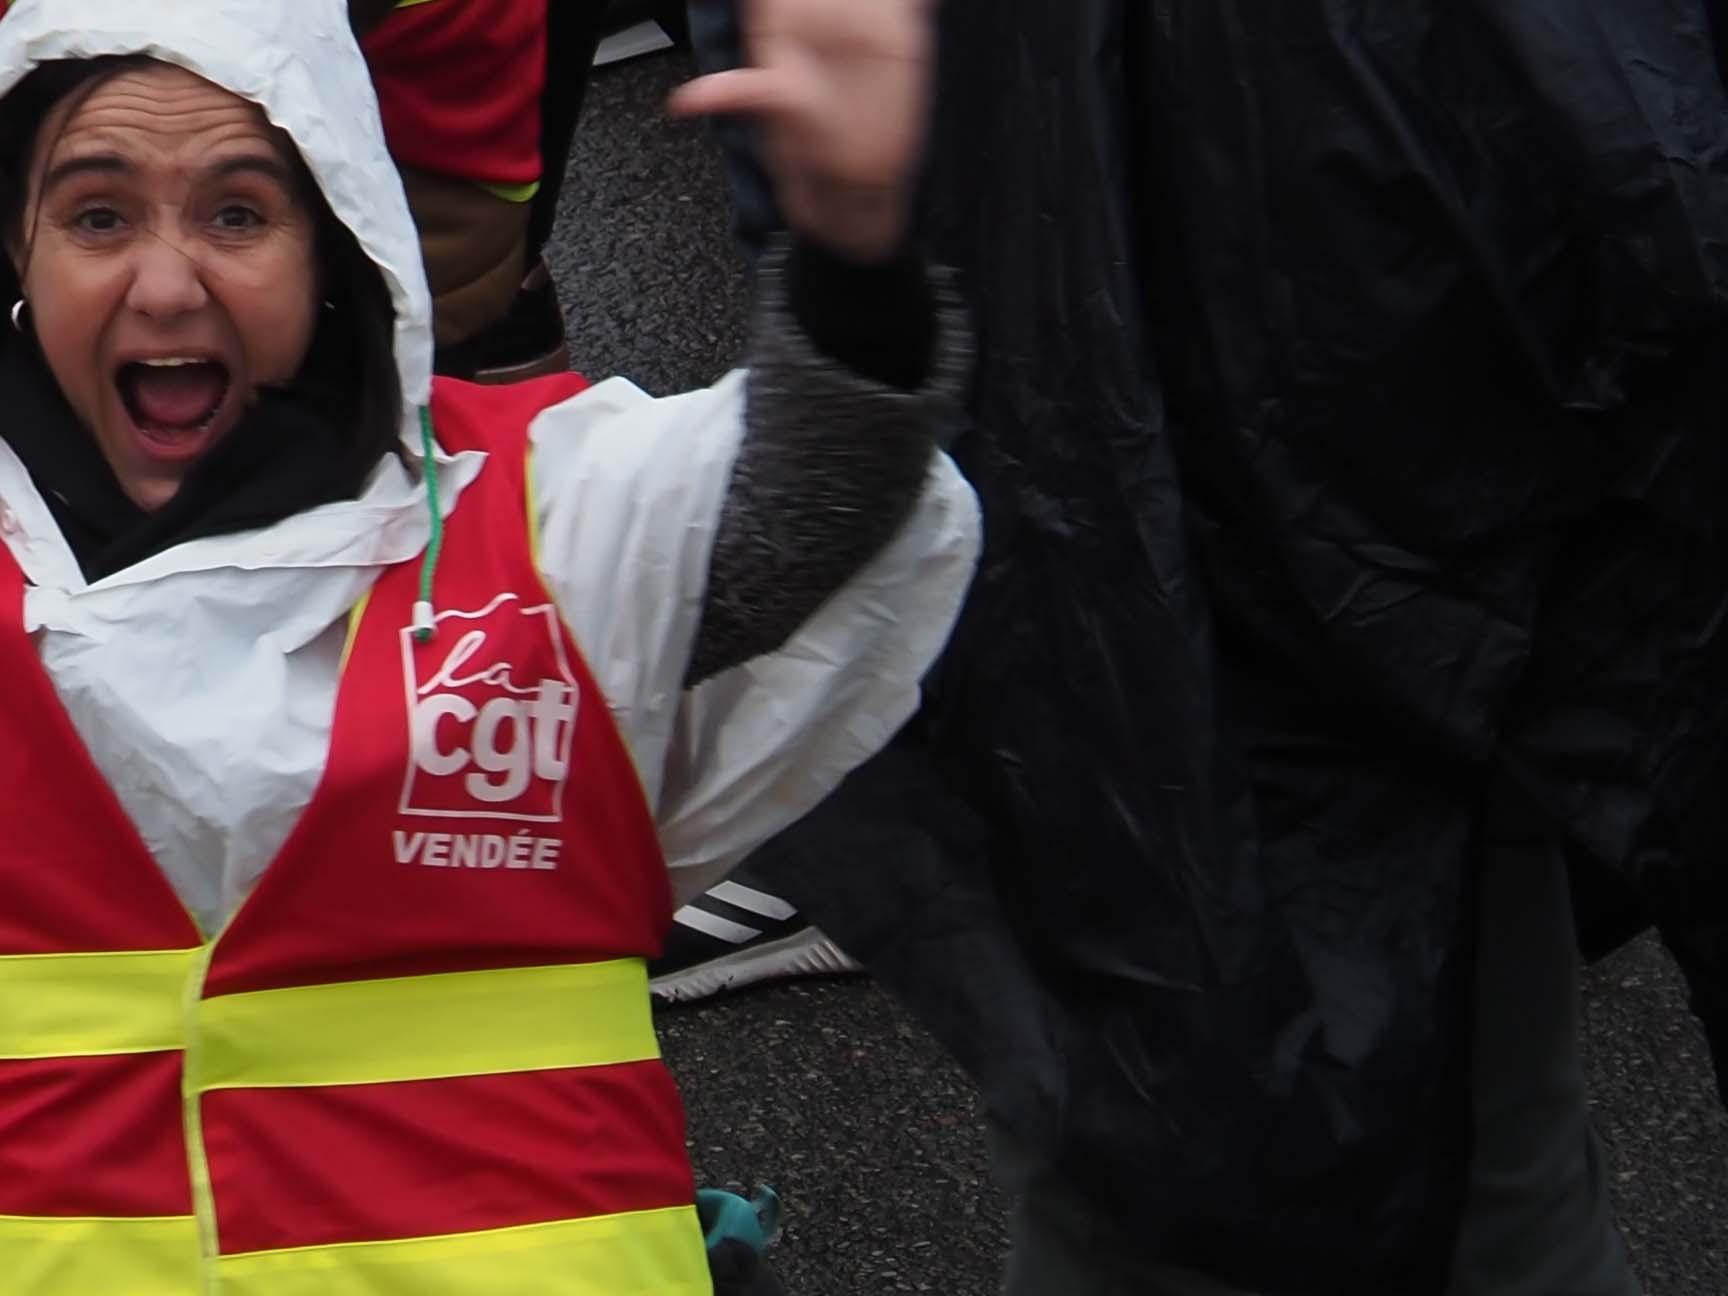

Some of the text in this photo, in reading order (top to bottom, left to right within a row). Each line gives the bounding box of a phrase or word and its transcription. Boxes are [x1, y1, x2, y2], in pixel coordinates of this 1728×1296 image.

[416, 629, 532, 696] la
[412, 678, 575, 803] cgt
[392, 829, 564, 870] VENDÉE
